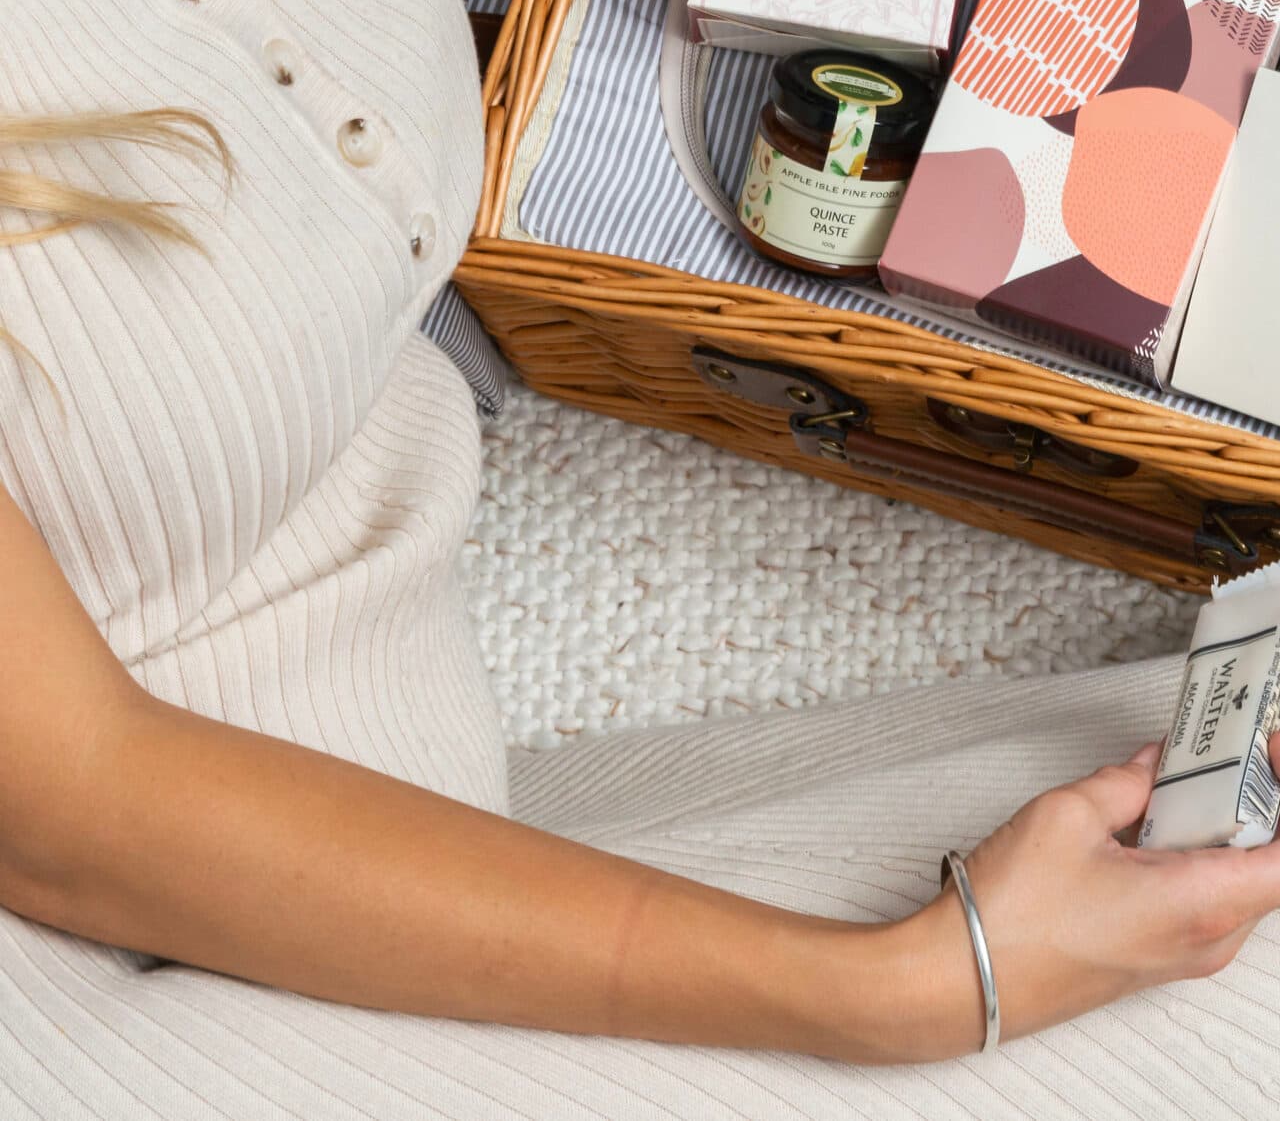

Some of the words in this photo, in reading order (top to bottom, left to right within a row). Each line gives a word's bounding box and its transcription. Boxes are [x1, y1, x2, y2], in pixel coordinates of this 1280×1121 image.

[781, 168, 813, 187] APPLE
[815, 181, 840, 194] ISLE
[842, 188, 868, 198] FINE
[810, 206, 857, 225] QUINCE
[813, 222, 849, 239] PASTE
[1172, 682, 1199, 749] MACADAMIA
[1195, 658, 1237, 756] WALTERS
